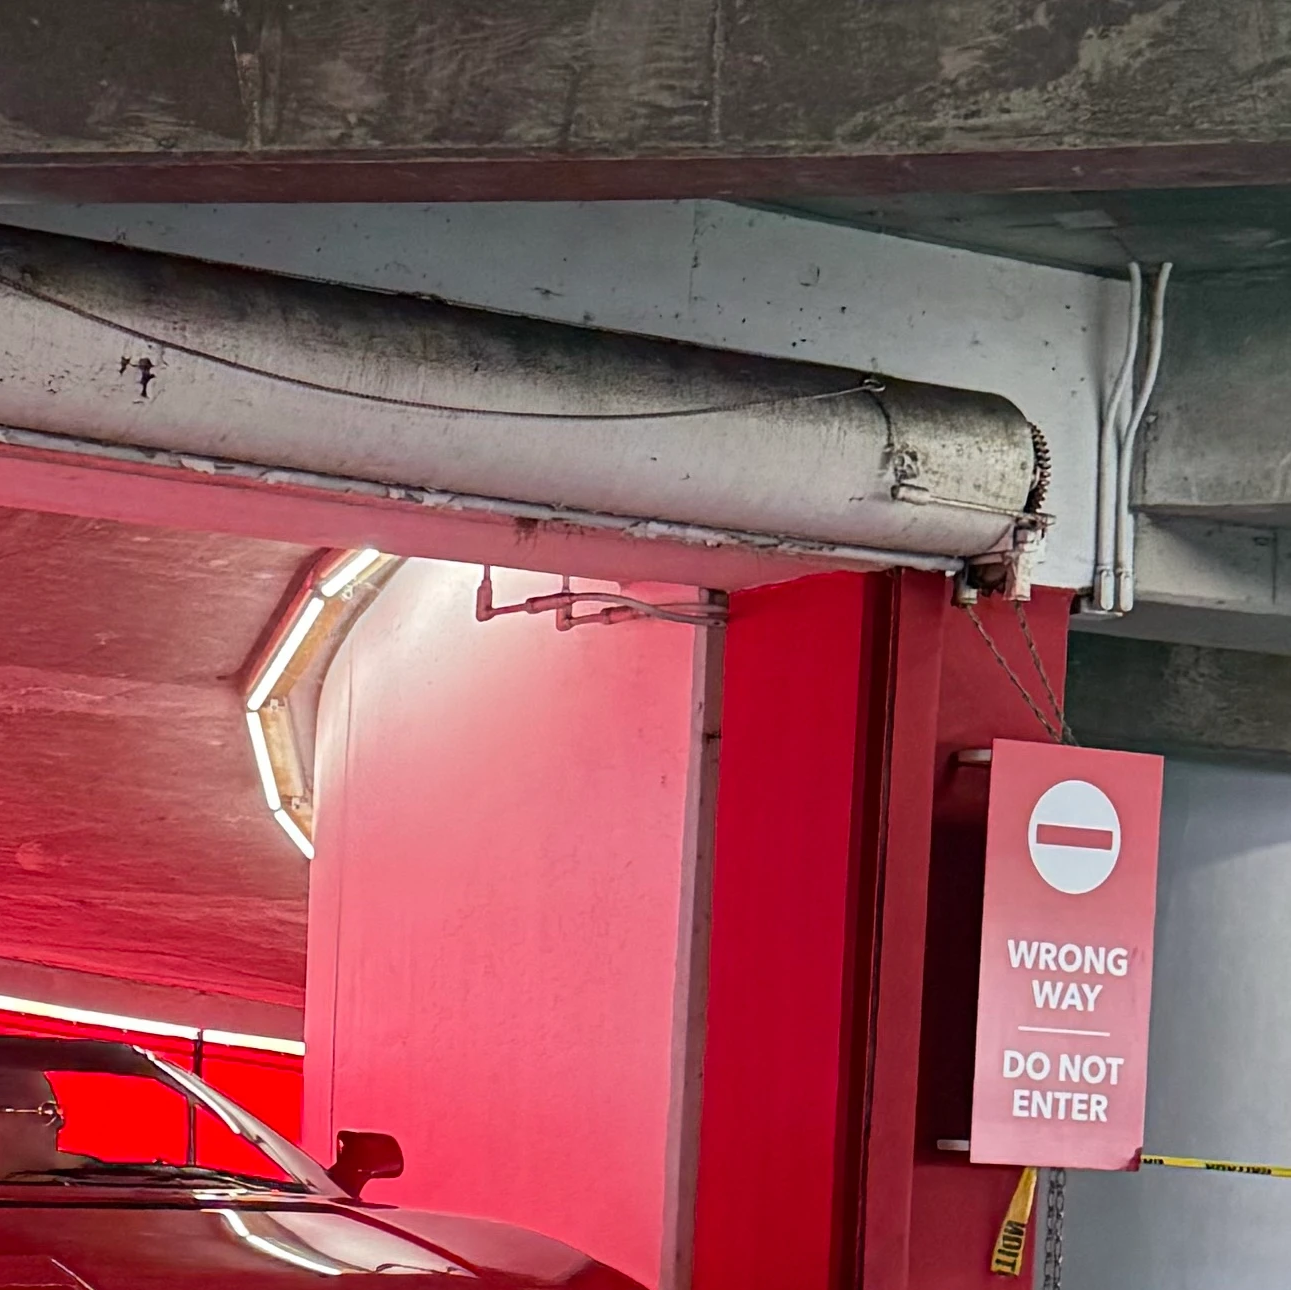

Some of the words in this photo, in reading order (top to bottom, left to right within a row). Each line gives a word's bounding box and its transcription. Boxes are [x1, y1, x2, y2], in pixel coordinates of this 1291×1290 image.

[1008, 939, 1128, 976] WRONG
[1032, 980, 1103, 1012] WAY
[1002, 1050, 1051, 1080] DO
[1059, 1054, 1124, 1085] NOT
[1012, 1089, 1108, 1122] ENTER
